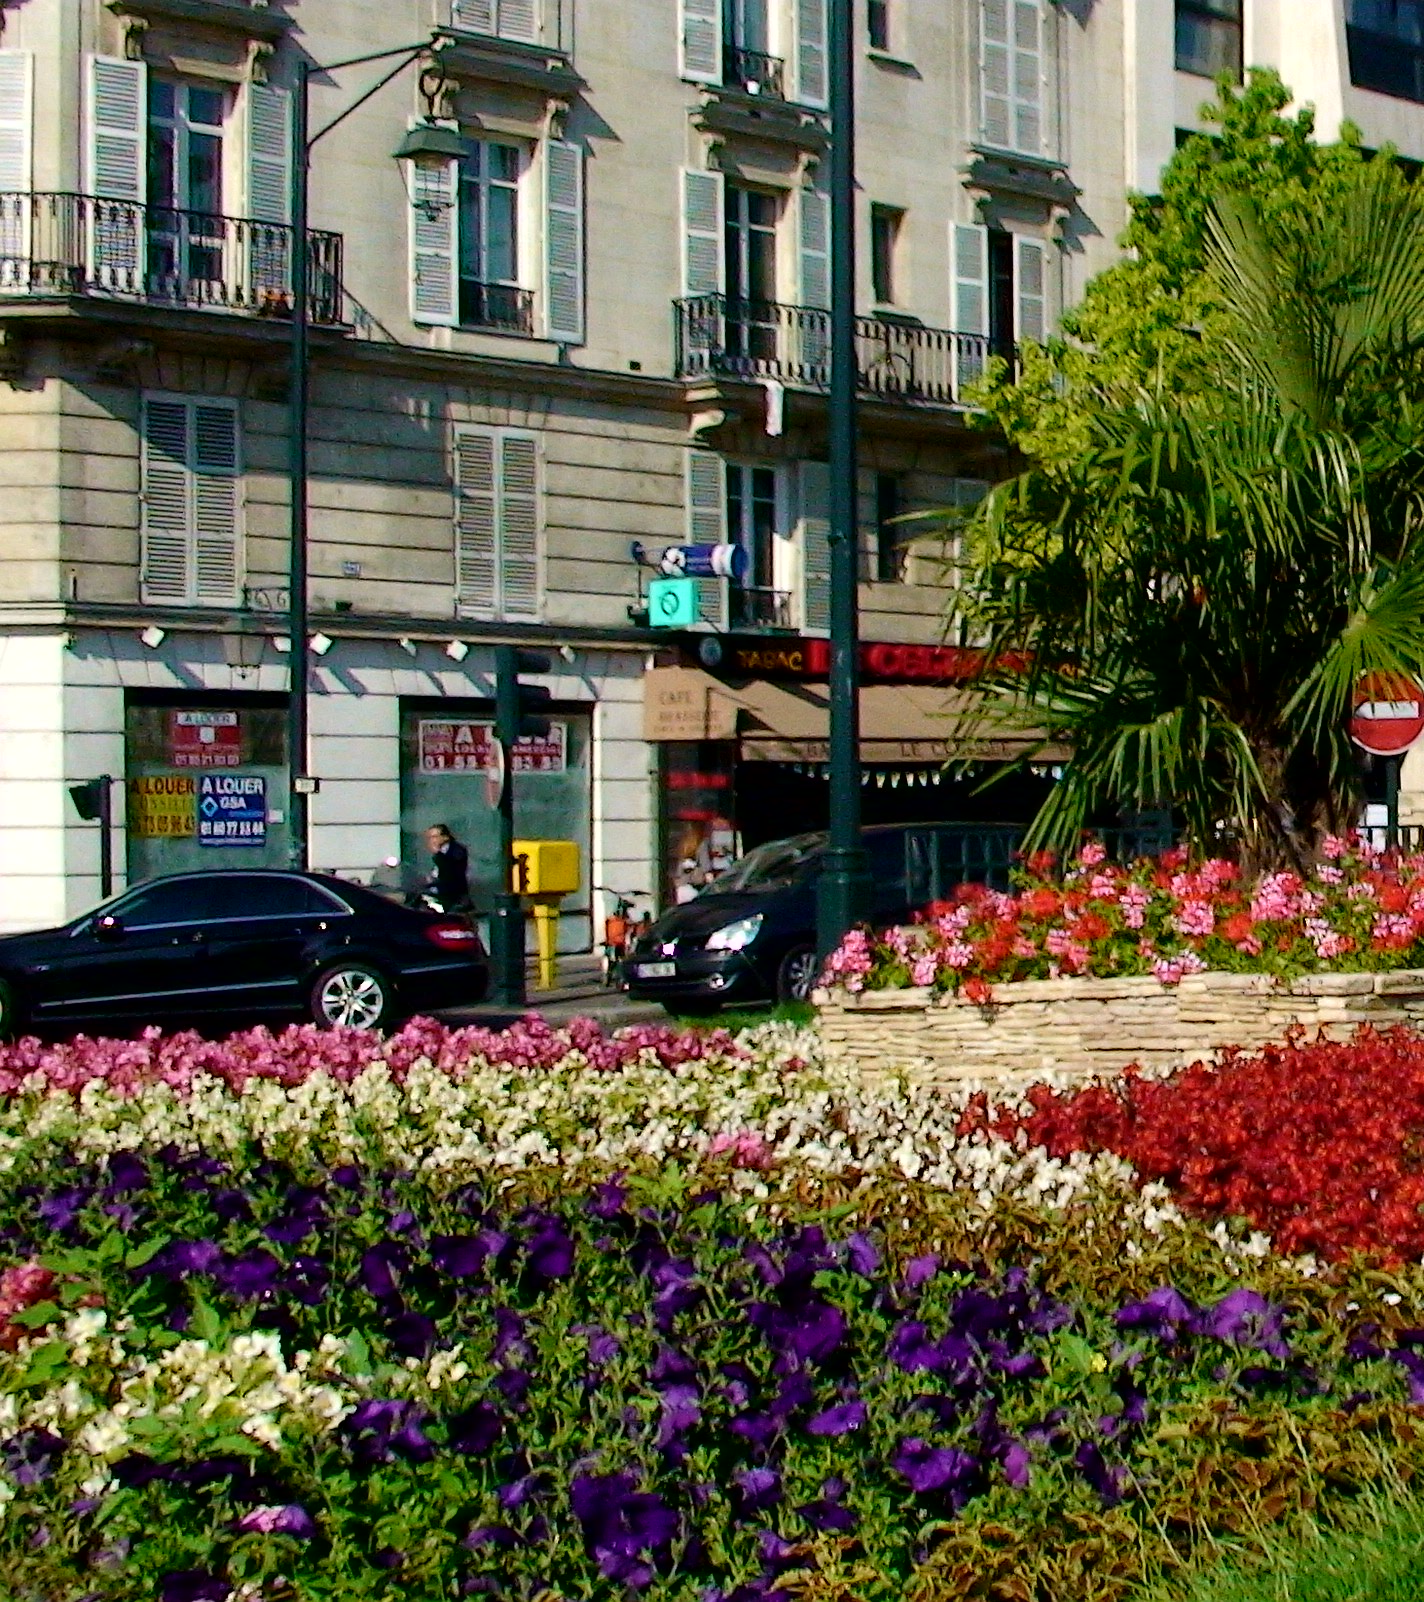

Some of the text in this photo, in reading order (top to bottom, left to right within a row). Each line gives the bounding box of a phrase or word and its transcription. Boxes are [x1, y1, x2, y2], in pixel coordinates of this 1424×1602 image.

[144, 777, 195, 795] LOUER
[202, 776, 263, 794] A LOUER
